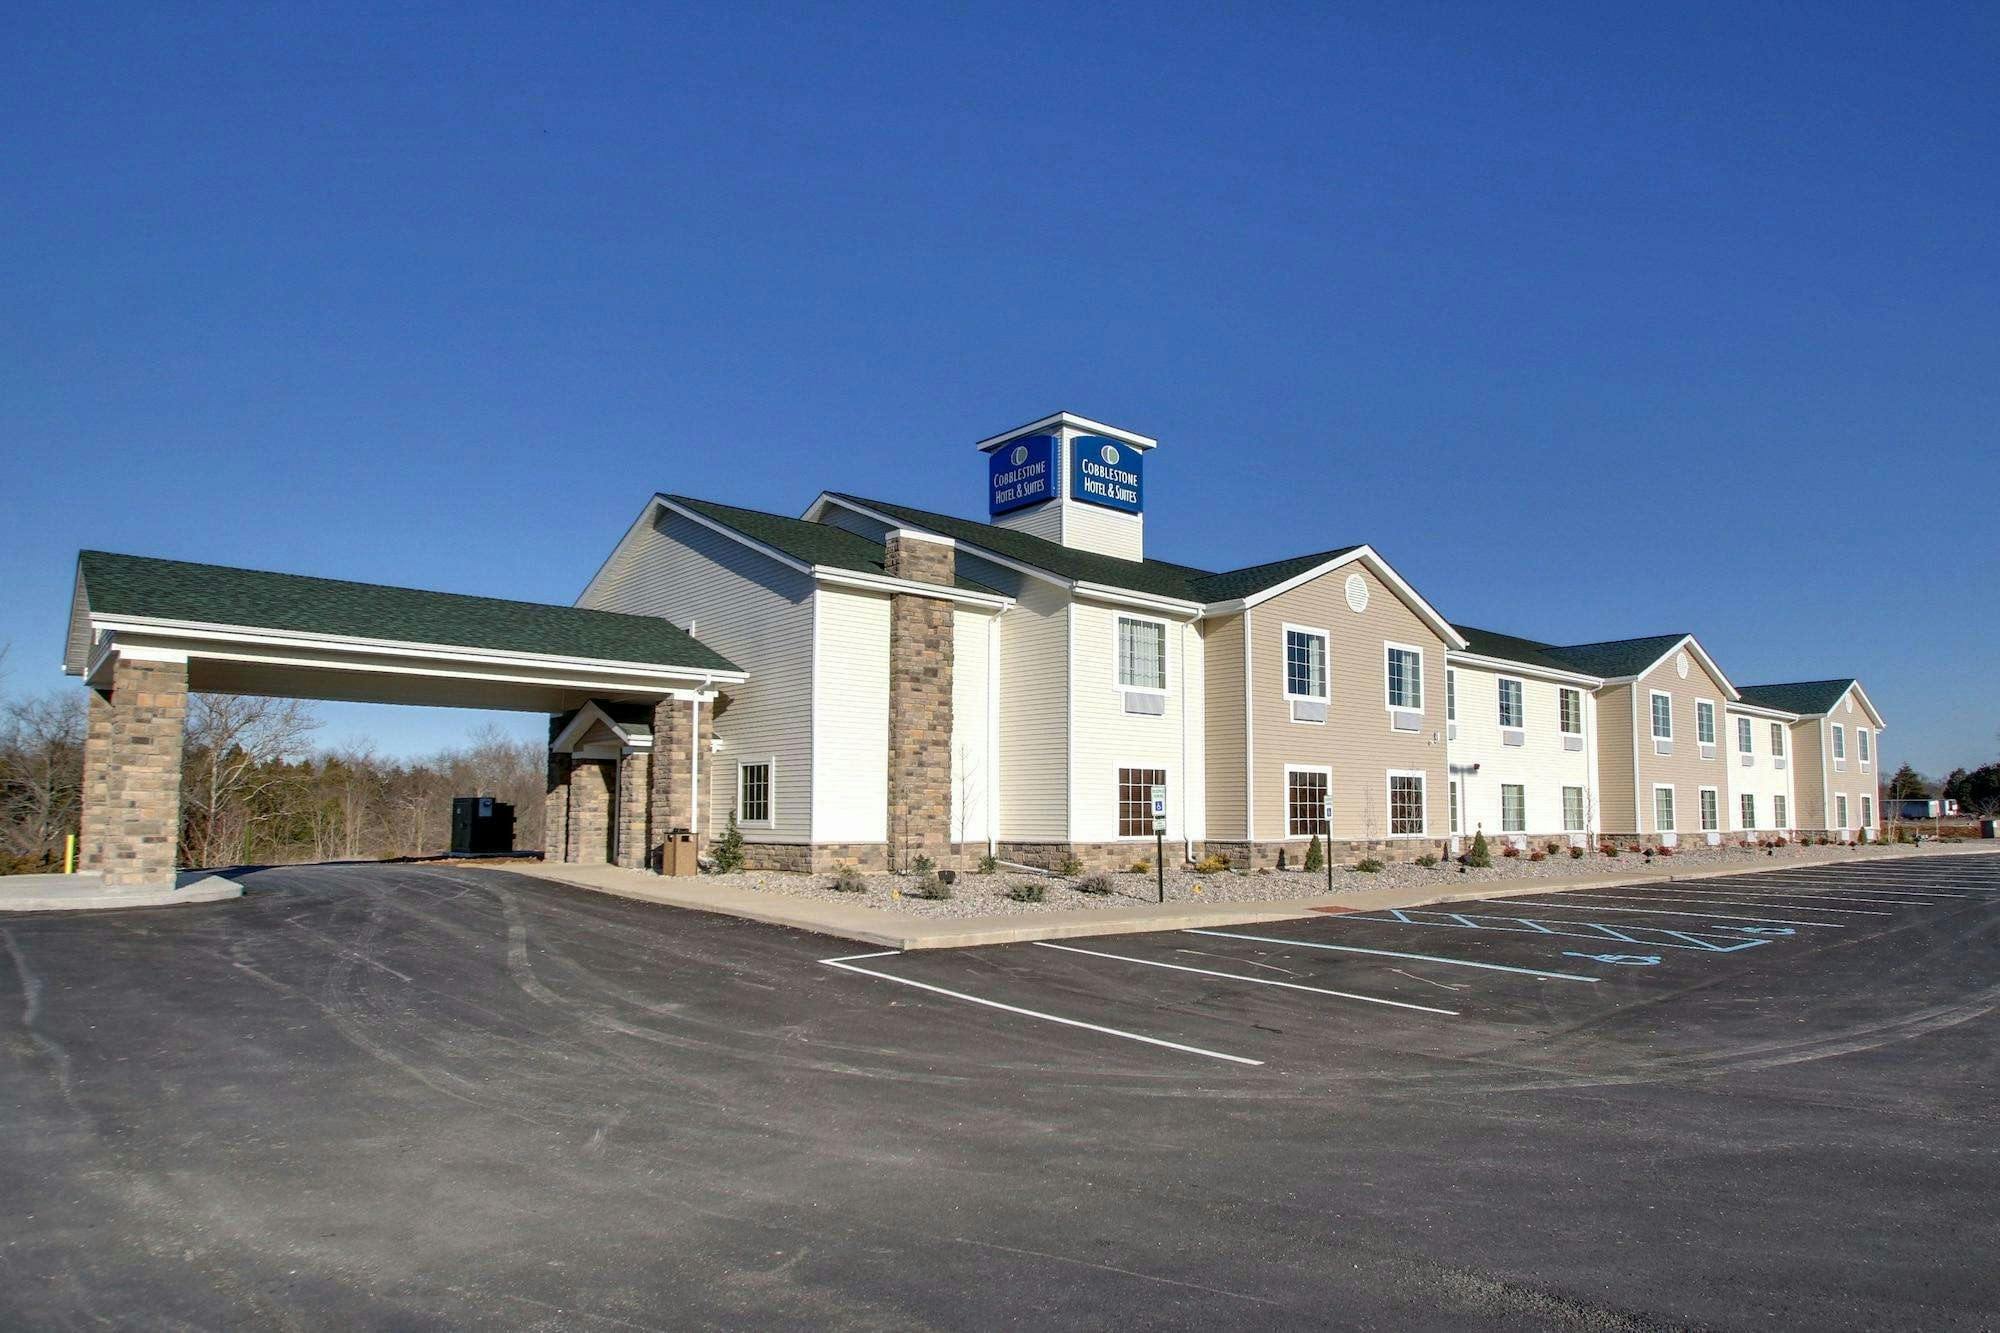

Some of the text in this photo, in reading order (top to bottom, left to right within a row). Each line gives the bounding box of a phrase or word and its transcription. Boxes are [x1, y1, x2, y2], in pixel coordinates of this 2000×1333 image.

[993, 460, 1046, 487] COBBLESTONE
[1082, 458, 1138, 487] COBBLESTONE
[995, 478, 1045, 505] HOTEL & SUITES
[1084, 477, 1137, 504] HOTEL & SUITES
